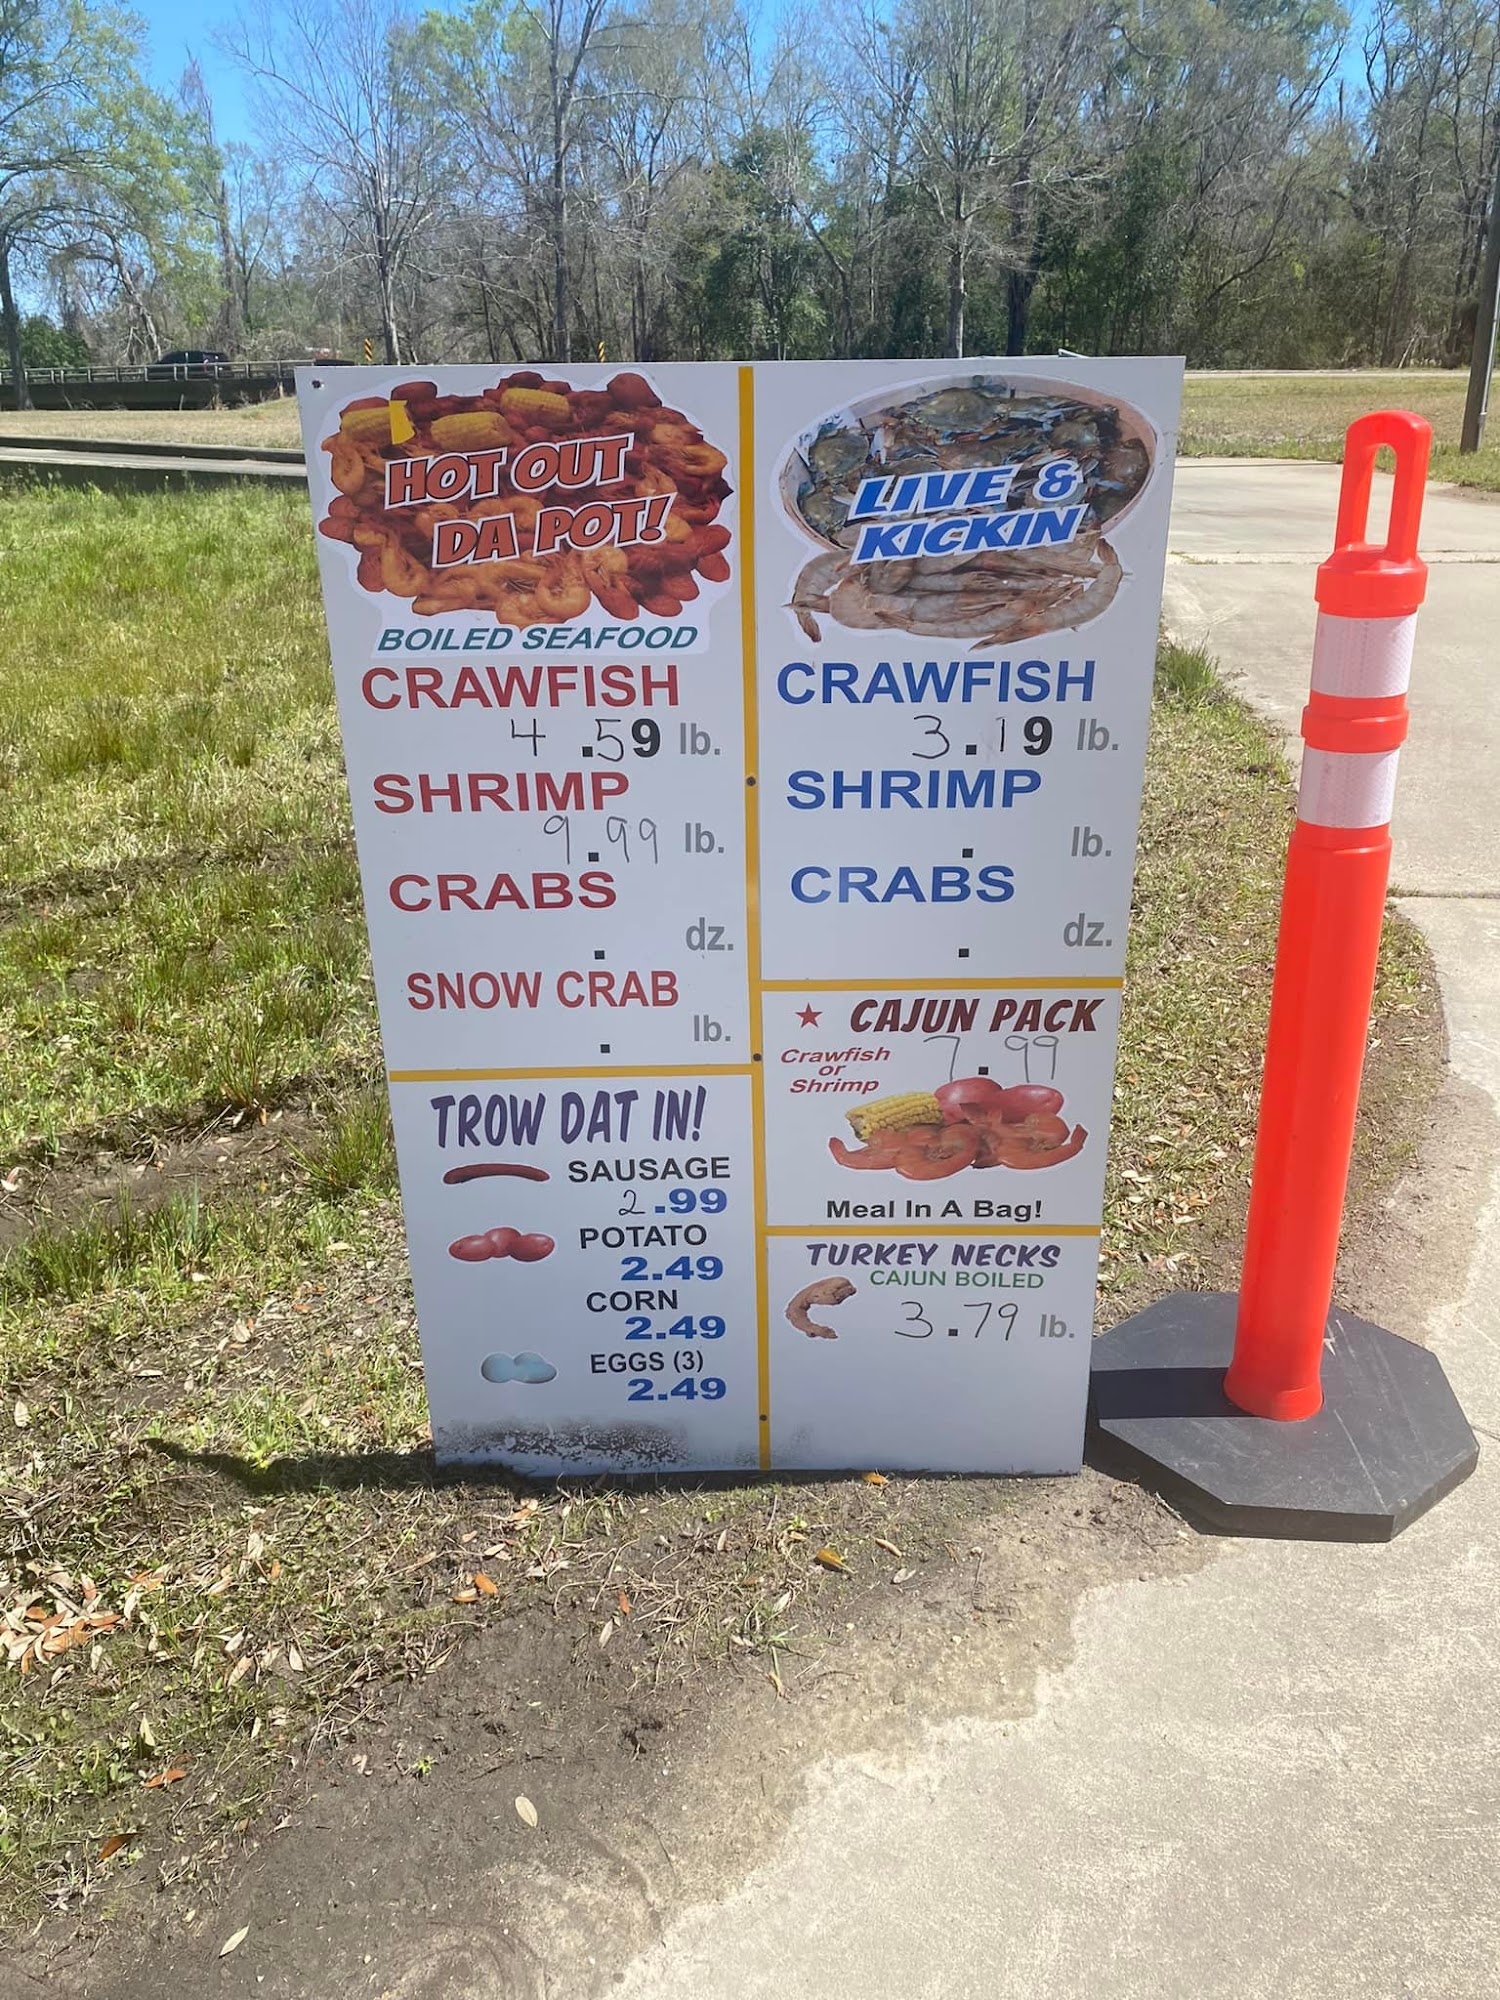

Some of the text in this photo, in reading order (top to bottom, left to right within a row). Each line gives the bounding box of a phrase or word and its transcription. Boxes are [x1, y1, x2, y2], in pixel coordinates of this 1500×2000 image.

[387, 434, 634, 508] HOT OUT
[853, 462, 1080, 517] LIVE &
[433, 495, 674, 567] DA POT!
[856, 505, 1085, 561] KICKIN
[377, 626, 698, 652] BOILED SEAFOOD
[361, 664, 680, 709] CRAWFISH
[777, 660, 1096, 704] CRAWFISH
[679, 722, 722, 755] lb.
[1076, 718, 1119, 751] lb.
[372, 772, 629, 814] SHRIMP
[786, 769, 1042, 810] SHRIMP
[684, 822, 725, 854] lb.
[1070, 826, 1112, 857] lb.
[389, 871, 617, 912] CRABS
[790, 865, 1015, 904] CRABS
[685, 916, 734, 951] dz.
[1063, 912, 1113, 948] dz.
[407, 970, 680, 1010] SNOW CRAB
[693, 1015, 732, 1042] lb.
[850, 998, 1106, 1033] CAJUN PACK
[780, 1047, 891, 1064] Crawfish
[818, 1063, 845, 1077] or
[789, 1077, 880, 1094] Shrimp
[430, 1085, 707, 1148] TROW DAT IN!
[568, 1156, 731, 1183] SAUSAGE
[826, 1200, 1042, 1222] Meal In A Bag!
[579, 1224, 707, 1249] POTATO
[620, 1256, 723, 1281] 2.49
[806, 1242, 1061, 1268] TURKEY NECKS
[870, 1270, 1044, 1289] CAJUN BOILED
[586, 1289, 678, 1312] CORN
[624, 1315, 726, 1340] 2.49
[1039, 1313, 1075, 1338] lb.
[590, 1350, 704, 1374] EGGS (3)
[627, 1377, 727, 1401] 2.49
